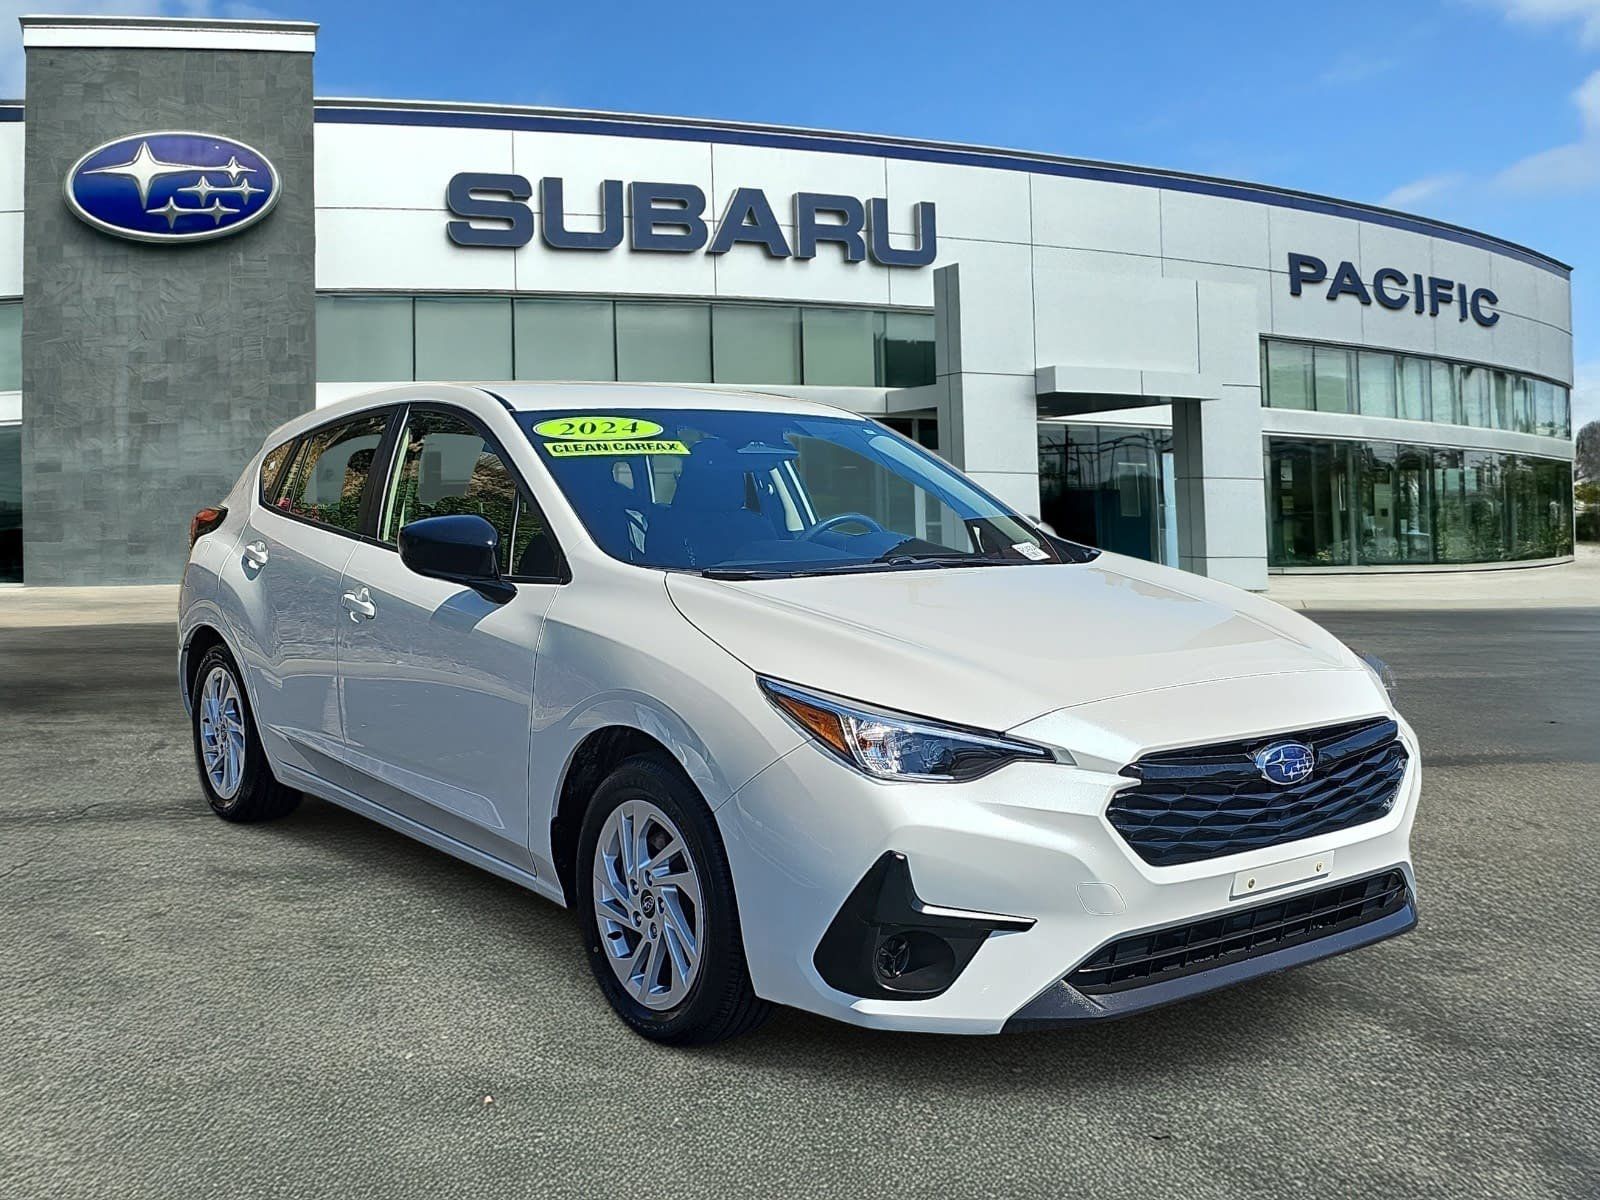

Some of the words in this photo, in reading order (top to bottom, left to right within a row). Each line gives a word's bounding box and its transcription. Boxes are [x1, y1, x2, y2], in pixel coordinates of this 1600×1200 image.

[446, 171, 937, 267] SUBARU
[1288, 252, 1500, 327] PACIFIC
[552, 442, 608, 454] CLEAN
[613, 441, 679, 452] CARFAX
[560, 421, 639, 435] 2024
